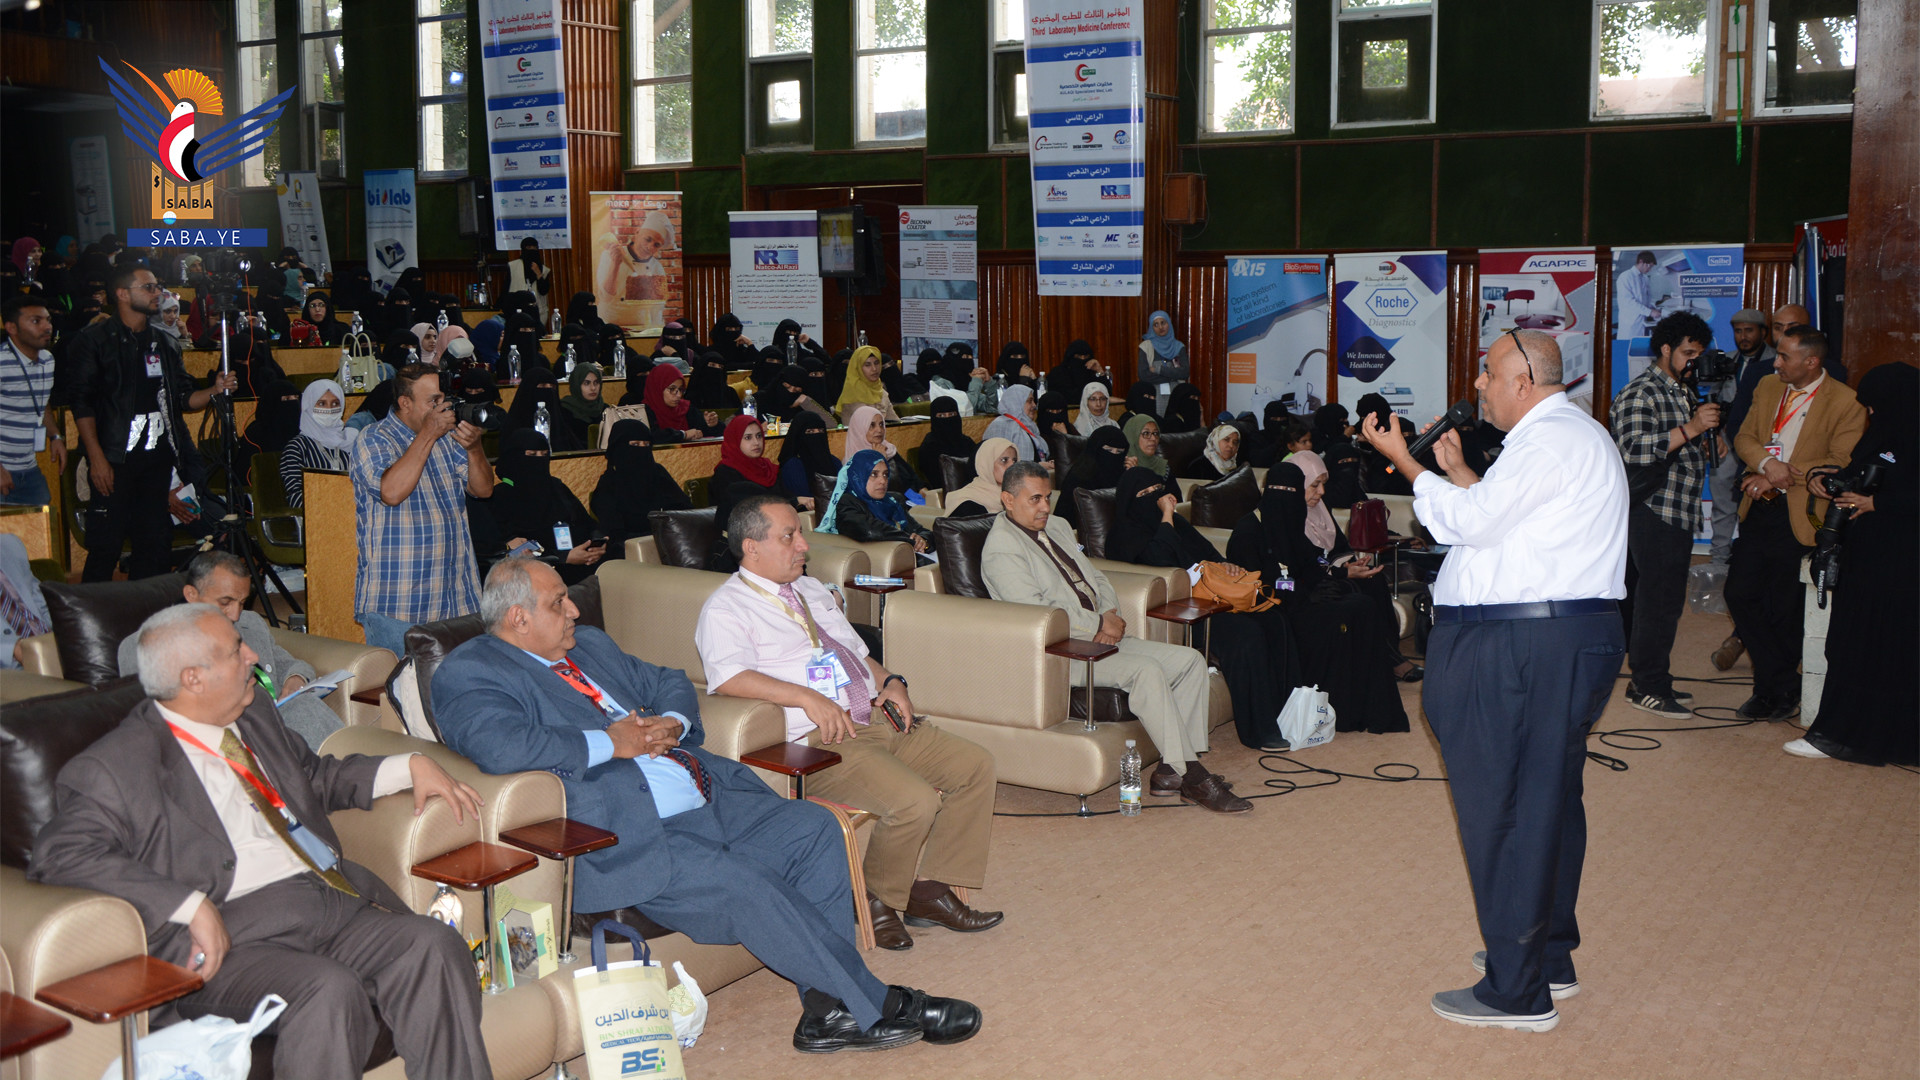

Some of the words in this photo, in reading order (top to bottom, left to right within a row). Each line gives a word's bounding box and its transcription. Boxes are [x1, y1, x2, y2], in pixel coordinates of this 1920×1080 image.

[1062, 11, 1082, 21] للطب
[1084, 9, 1104, 18] الثالث
[1107, 7, 1130, 18] المؤتمر
[1032, 14, 1059, 24] المخبري
[1032, 27, 1045, 36] Third
[1048, 26, 1076, 35] Laboratory
[1078, 23, 1099, 32] Medicine
[1100, 21, 1130, 31] Conference
[1064, 48, 1085, 58] الرسمي
[1086, 46, 1106, 57] الراعي
[1065, 115, 1082, 124] الماسي
[1084, 114, 1104, 123] الراعي
[1067, 168, 1089, 177] الذهبي
[1090, 167, 1110, 177] الراعي
[1069, 216, 1088, 225] الفضي
[1090, 215, 1110, 224] الراعي
[1105, 234, 1120, 242] MC
[754, 250, 779, 264] NR
[1095, 264, 1114, 272] الراعي
[1285, 263, 1319, 271] BioSystems
[1230, 294, 1250, 305] Open
[1251, 282, 1277, 297] system
[1233, 305, 1243, 314] for
[1244, 302, 1252, 310] all
[1253, 295, 1270, 306] kind
[1376, 296, 1409, 308] Roche
[1236, 315, 1244, 323] of
[1245, 300, 1287, 321] laboratories
[1369, 318, 1417, 329] Diagnostics
[631, 1003, 658, 1020] شرف
[660, 1008, 669, 1020] بن
[596, 1008, 629, 1026] الدين
